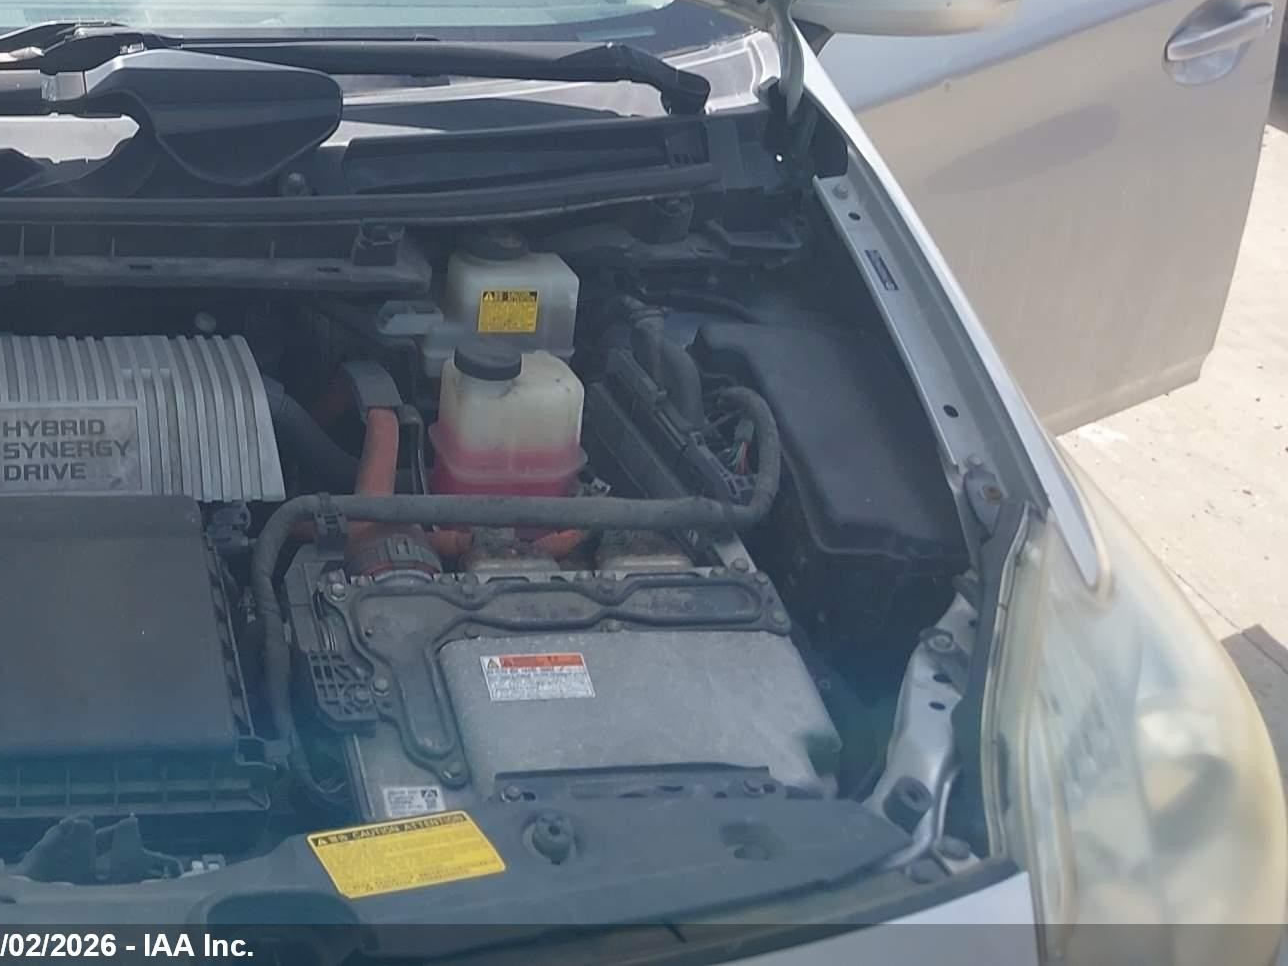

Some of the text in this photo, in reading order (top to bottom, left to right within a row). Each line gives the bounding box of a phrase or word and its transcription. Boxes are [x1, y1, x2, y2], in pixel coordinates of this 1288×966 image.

[3, 419, 106, 437] HYBRID
[3, 440, 131, 460] SYNERGY
[3, 463, 87, 482] DRIVE
[352, 825, 400, 839] CAUTION
[404, 814, 464, 832] ATTENTION
